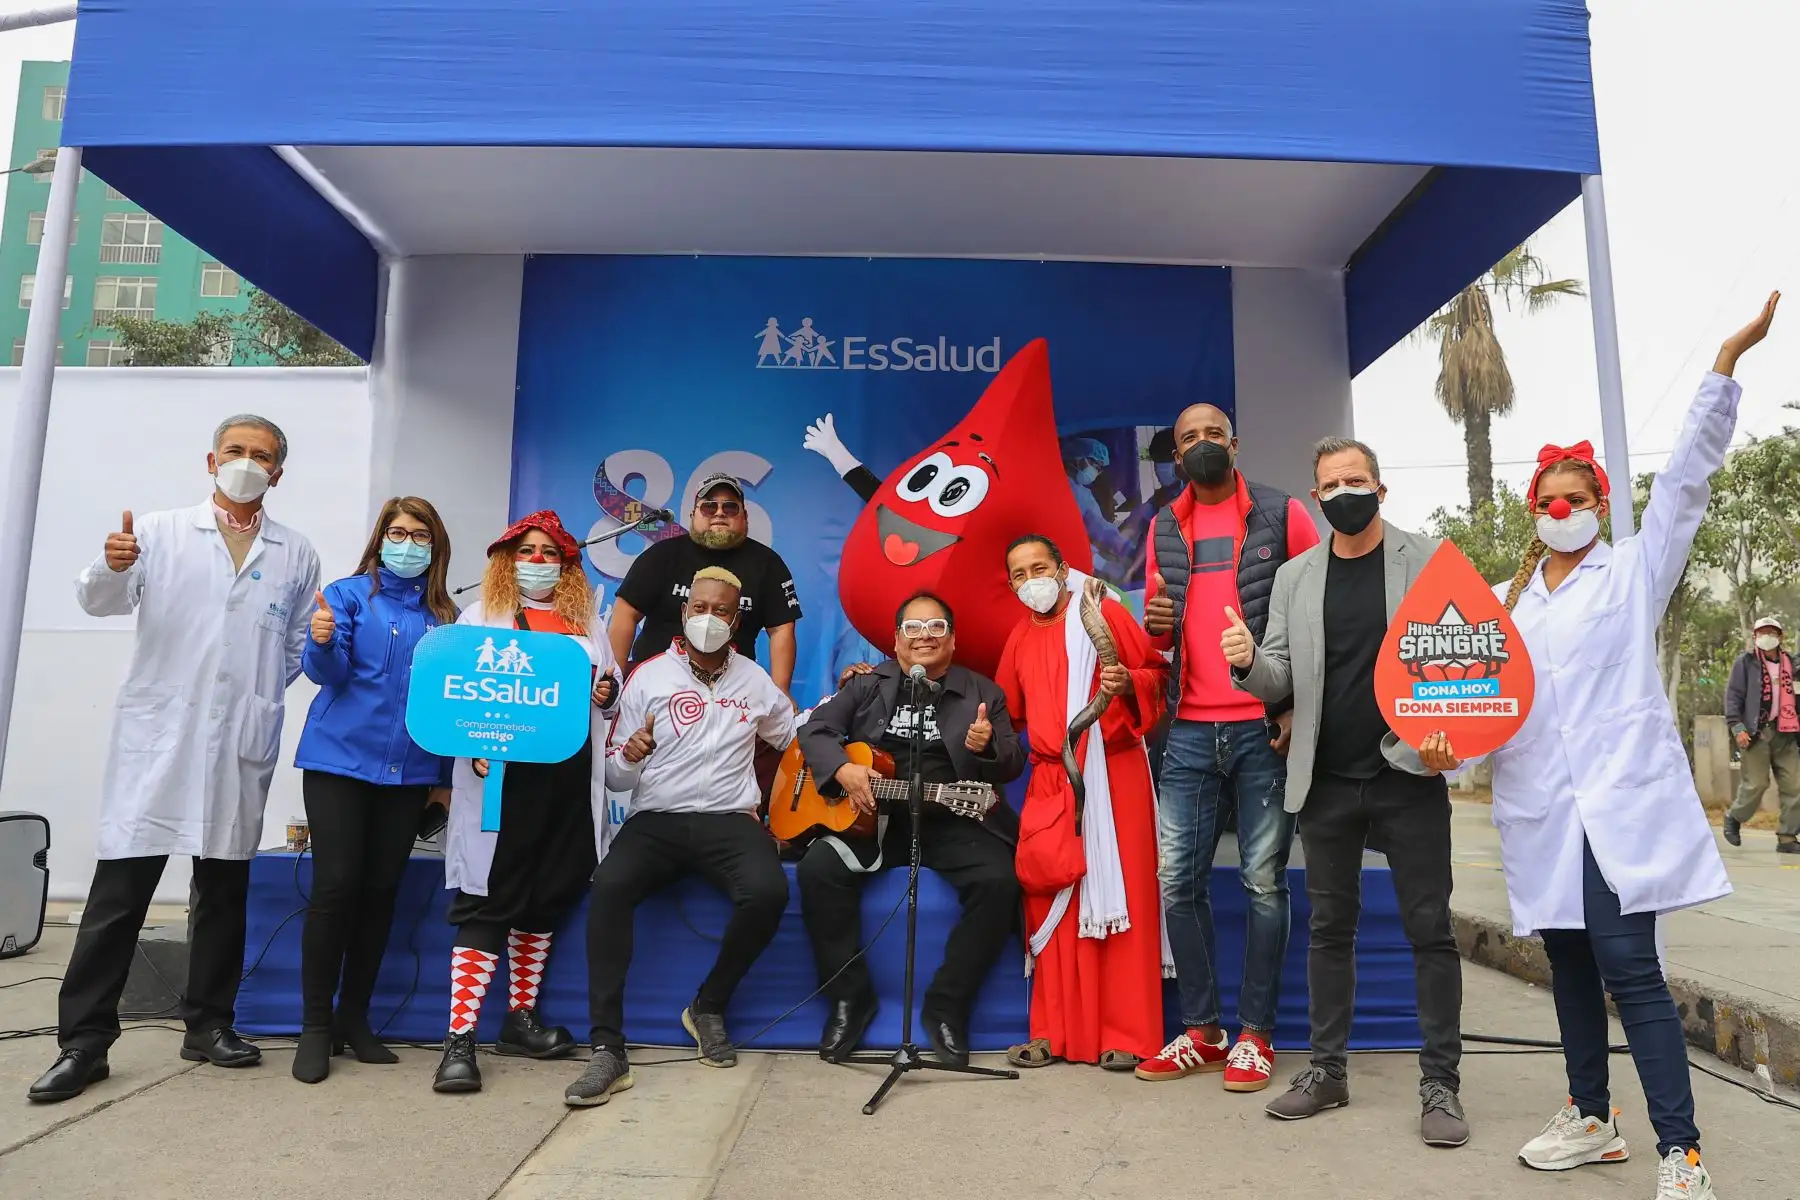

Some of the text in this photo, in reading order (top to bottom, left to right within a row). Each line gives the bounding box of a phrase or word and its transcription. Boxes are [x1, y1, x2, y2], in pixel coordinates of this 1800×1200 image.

[842, 335, 1001, 372] EsSalud
[1407, 619, 1500, 636] HINCHAS DE
[1398, 633, 1510, 661] SANGRE
[443, 674, 560, 707] EsSalud
[1418, 683, 1495, 697] DONA HOY,
[1399, 702, 1513, 714] DONA SIEMPRE
[455, 718, 537, 732] Comprometidos
[468, 730, 514, 742] contigo
